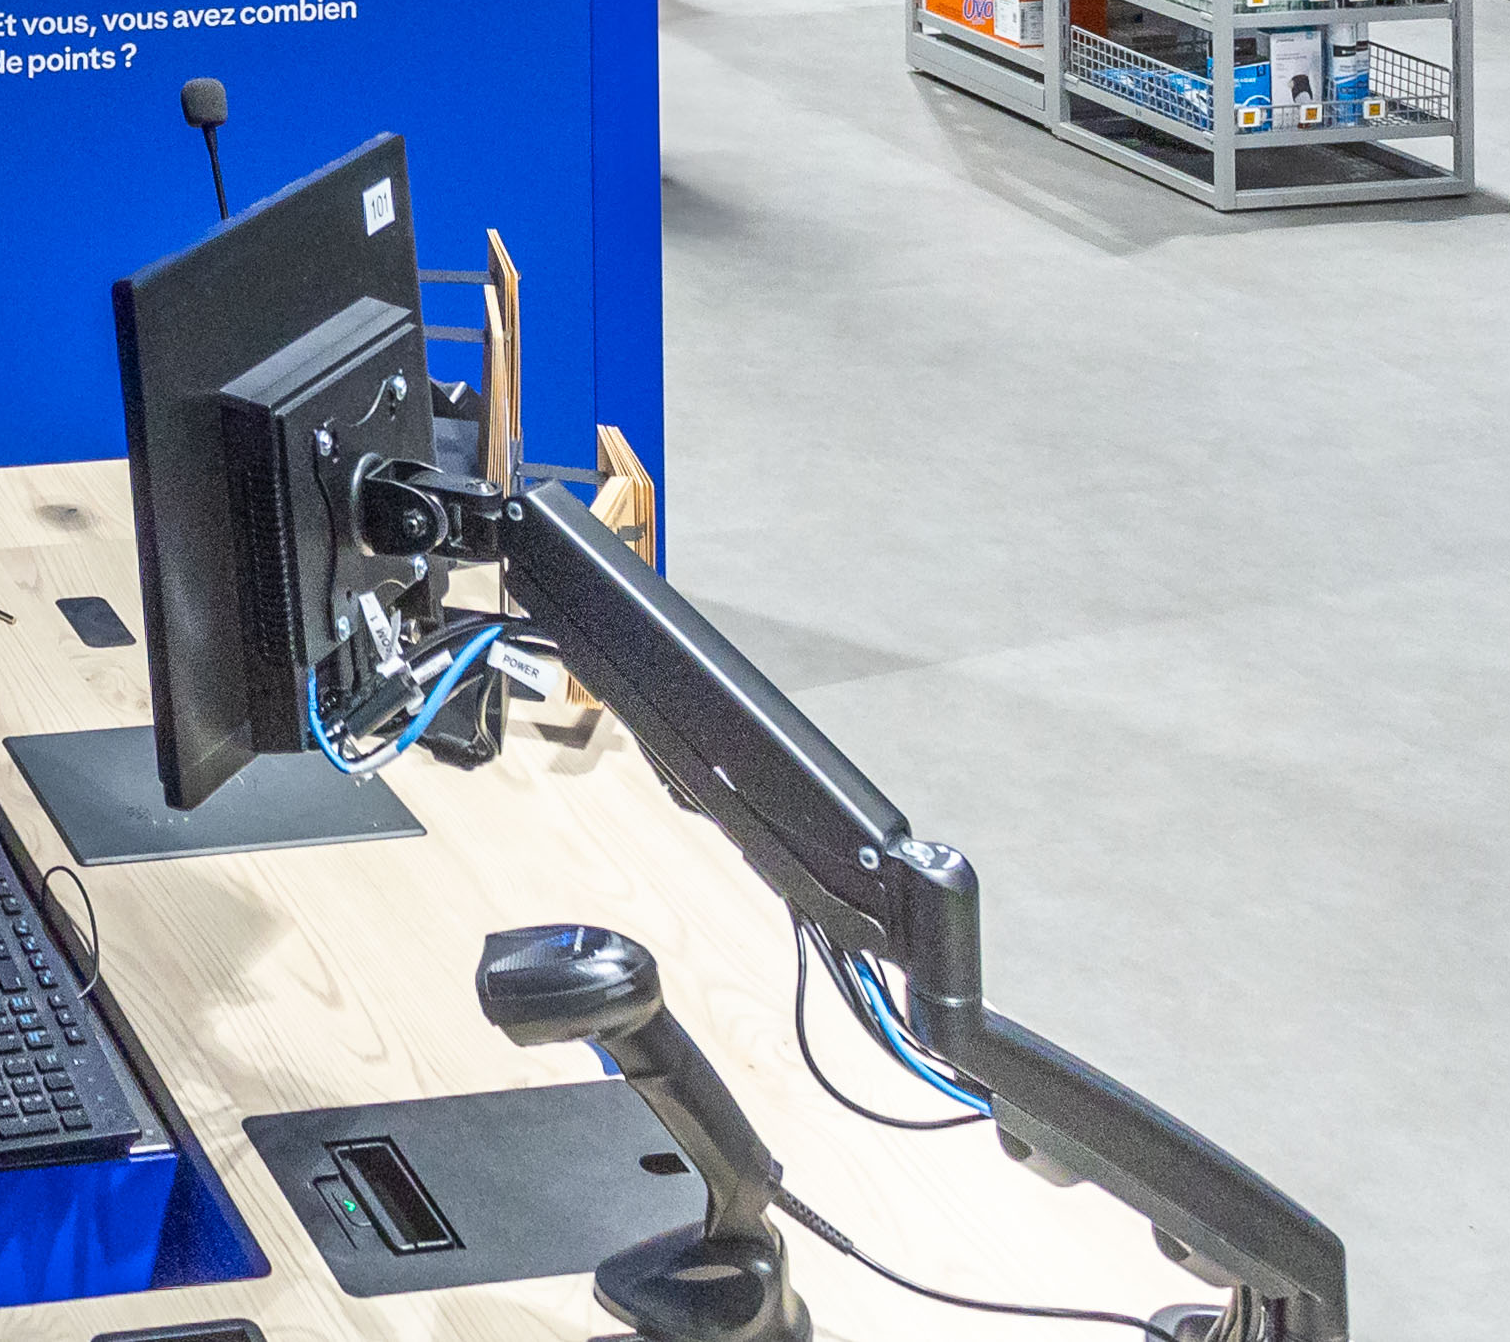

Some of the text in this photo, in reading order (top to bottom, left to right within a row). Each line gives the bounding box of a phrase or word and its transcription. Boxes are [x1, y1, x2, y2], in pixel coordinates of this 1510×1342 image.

[22, 13, 96, 37] vous,
[102, 11, 168, 31] vous
[173, 8, 236, 28] avez
[28, 47, 116, 78] points
[121, 43, 137, 67] ?
[371, 192, 389, 219] 101
[503, 653, 540, 679] POWER
